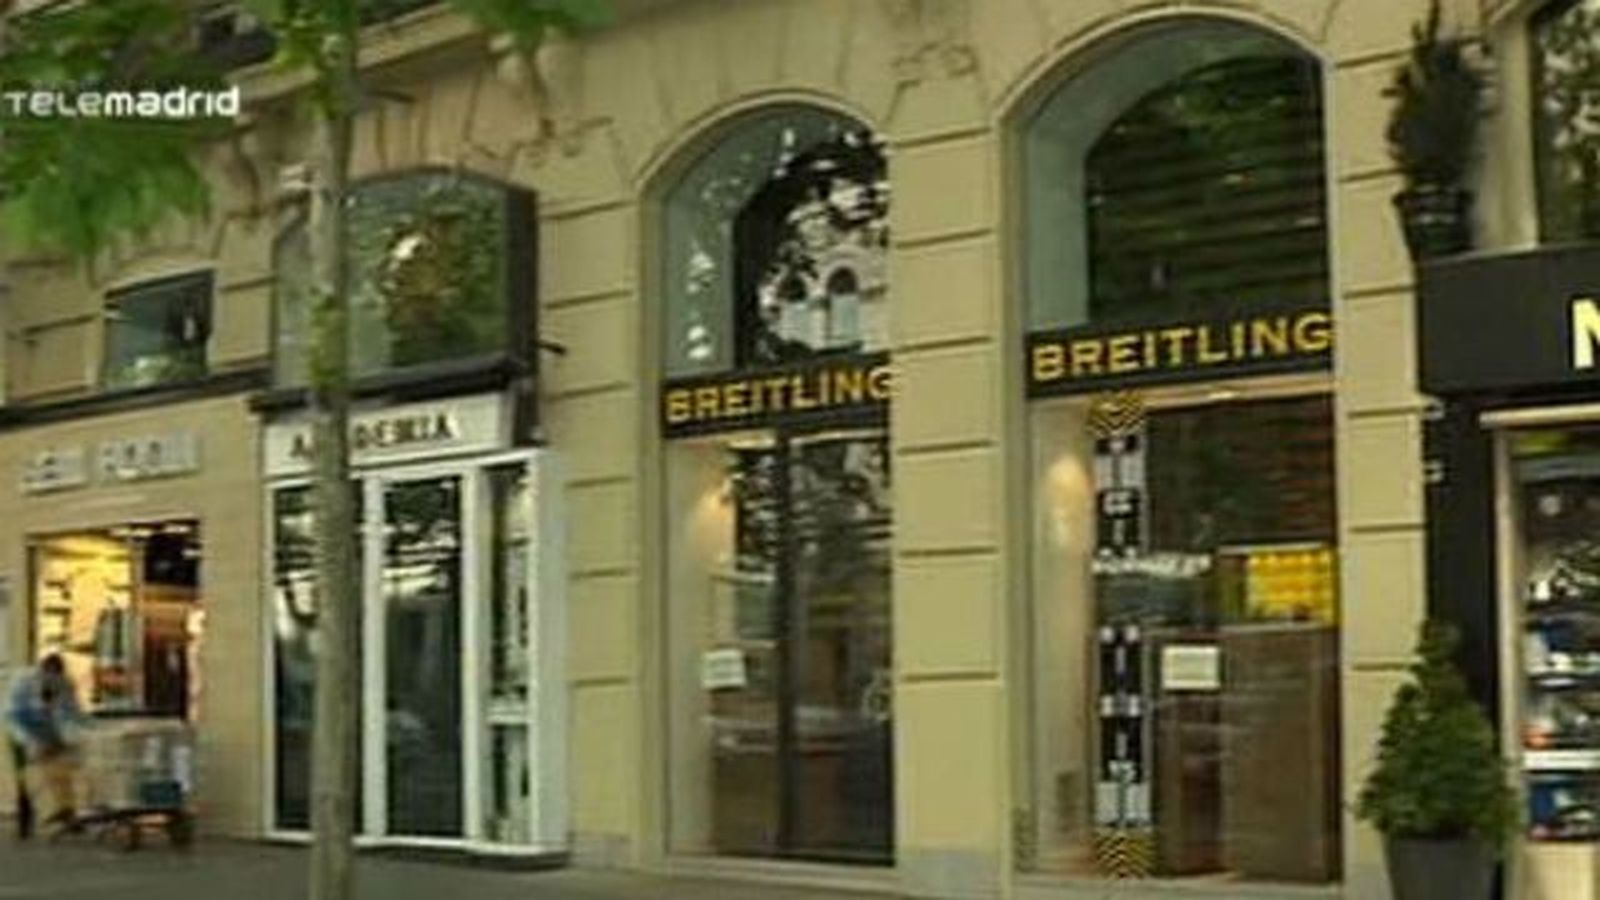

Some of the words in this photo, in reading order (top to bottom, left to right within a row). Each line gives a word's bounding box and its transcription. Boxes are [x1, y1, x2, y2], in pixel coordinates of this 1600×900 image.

[1033, 311, 1334, 381] BREITLING
[665, 365, 894, 424] BREITLING
[288, 412, 454, 461] ADEMIA
